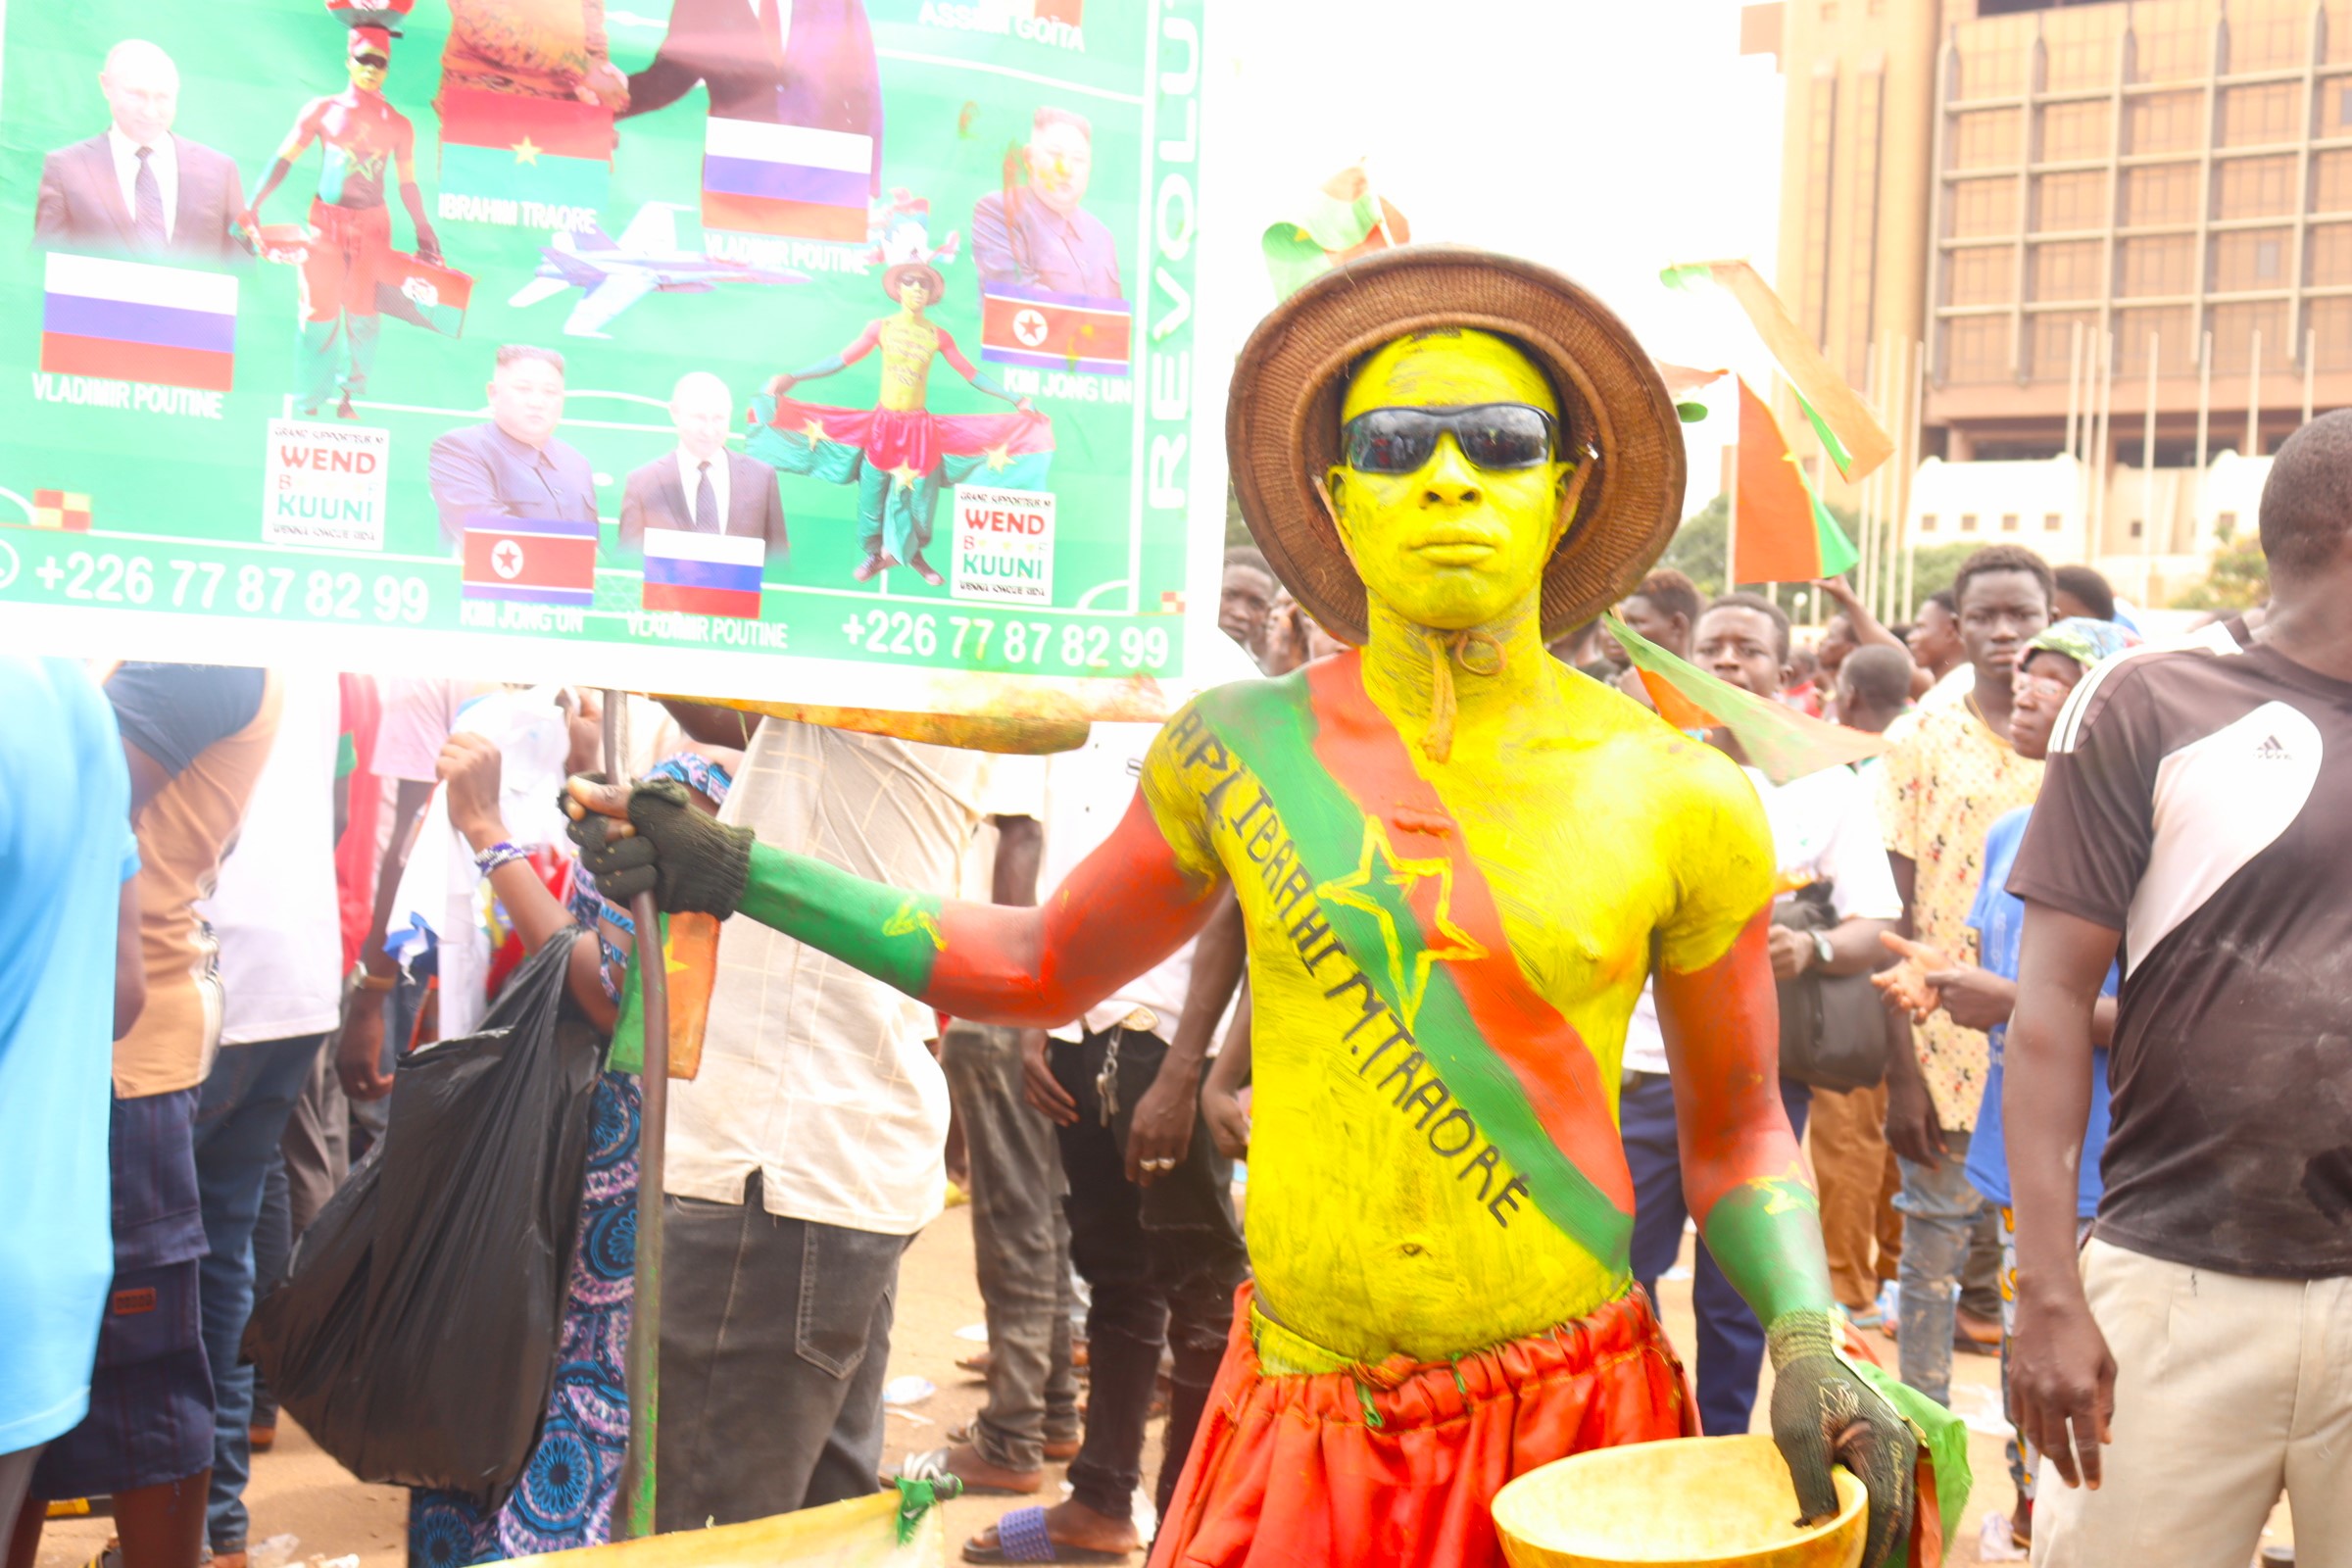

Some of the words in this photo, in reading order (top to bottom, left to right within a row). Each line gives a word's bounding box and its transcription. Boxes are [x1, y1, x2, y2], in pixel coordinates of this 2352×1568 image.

[1015, 15, 1086, 53] GOÏTA
[439, 193, 517, 226] IBRAHIM
[520, 200, 597, 234] TRAORE
[704, 232, 789, 267] VLADIMIR
[792, 241, 870, 275] POUTINE
[1149, 0, 1200, 509] REVOLU
[31, 372, 130, 409] VLADIMIR
[133, 382, 224, 420] POUTINE
[1004, 368, 1039, 395] KIM
[1043, 372, 1099, 401] JONG
[1102, 377, 1133, 404] UN
[280, 444, 377, 474] WEND
[278, 474, 292, 490] B
[277, 493, 373, 522] KUUNI
[964, 508, 1046, 535] WEND
[963, 535, 975, 550] B
[962, 553, 1043, 580] KUUNI
[36, 551, 154, 605] +226
[169, 560, 226, 610] 77
[235, 564, 295, 614] 87
[305, 569, 363, 619] 82
[372, 574, 429, 624] 99
[461, 598, 496, 627] KIM
[498, 602, 552, 631] JONG
[556, 605, 584, 633] UN
[627, 610, 709, 643] VLADIMIR
[711, 617, 789, 649] POUTINE
[842, 609, 937, 657] +226
[949, 615, 995, 661] 77
[1004, 620, 1052, 664] 87
[1061, 624, 1110, 667] 82
[1120, 626, 1169, 668] 99
